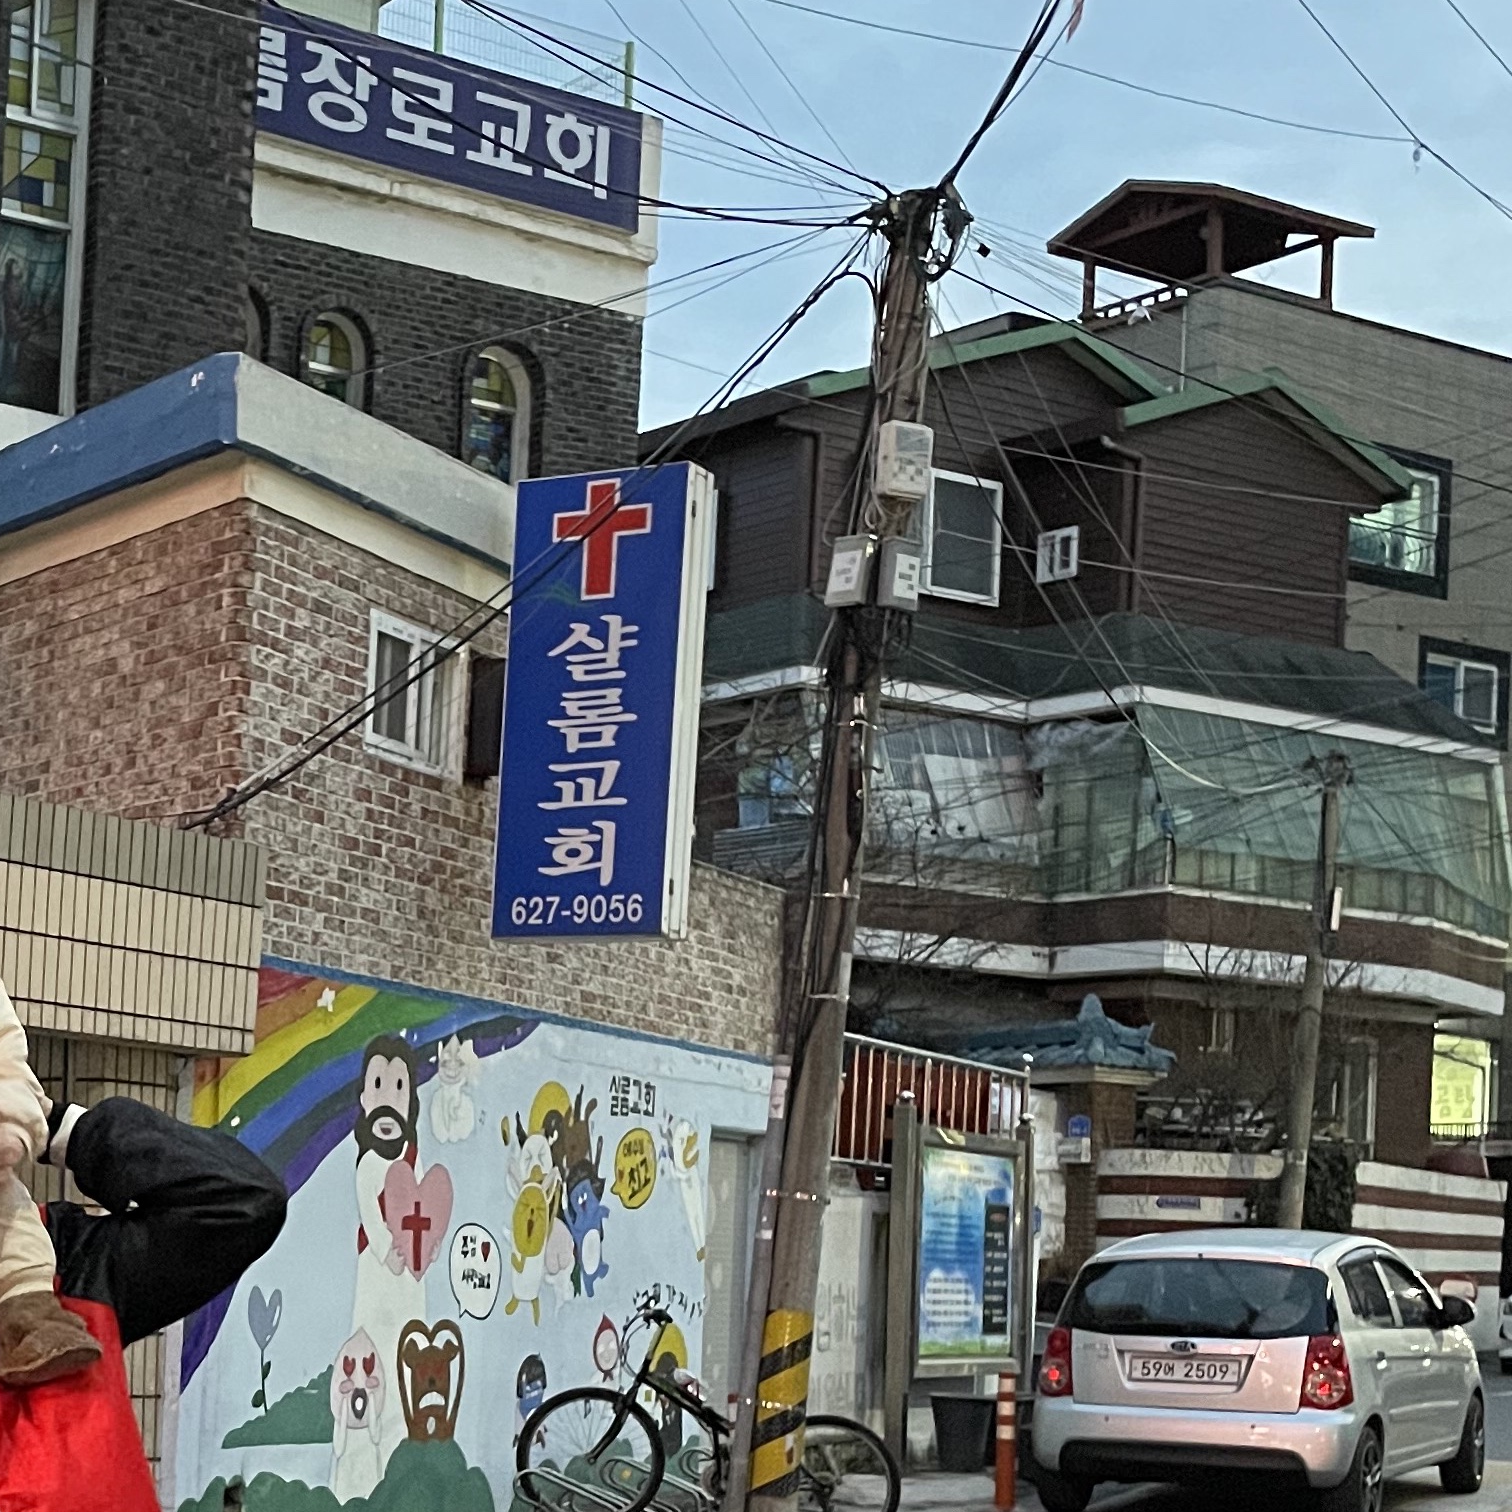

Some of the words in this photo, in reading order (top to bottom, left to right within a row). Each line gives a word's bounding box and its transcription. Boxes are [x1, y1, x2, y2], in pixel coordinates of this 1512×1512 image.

[537, 614, 640, 887] 샬롬교회
[511, 893, 644, 926] 627-9056
[1184, 1362, 1229, 1380] 2509
